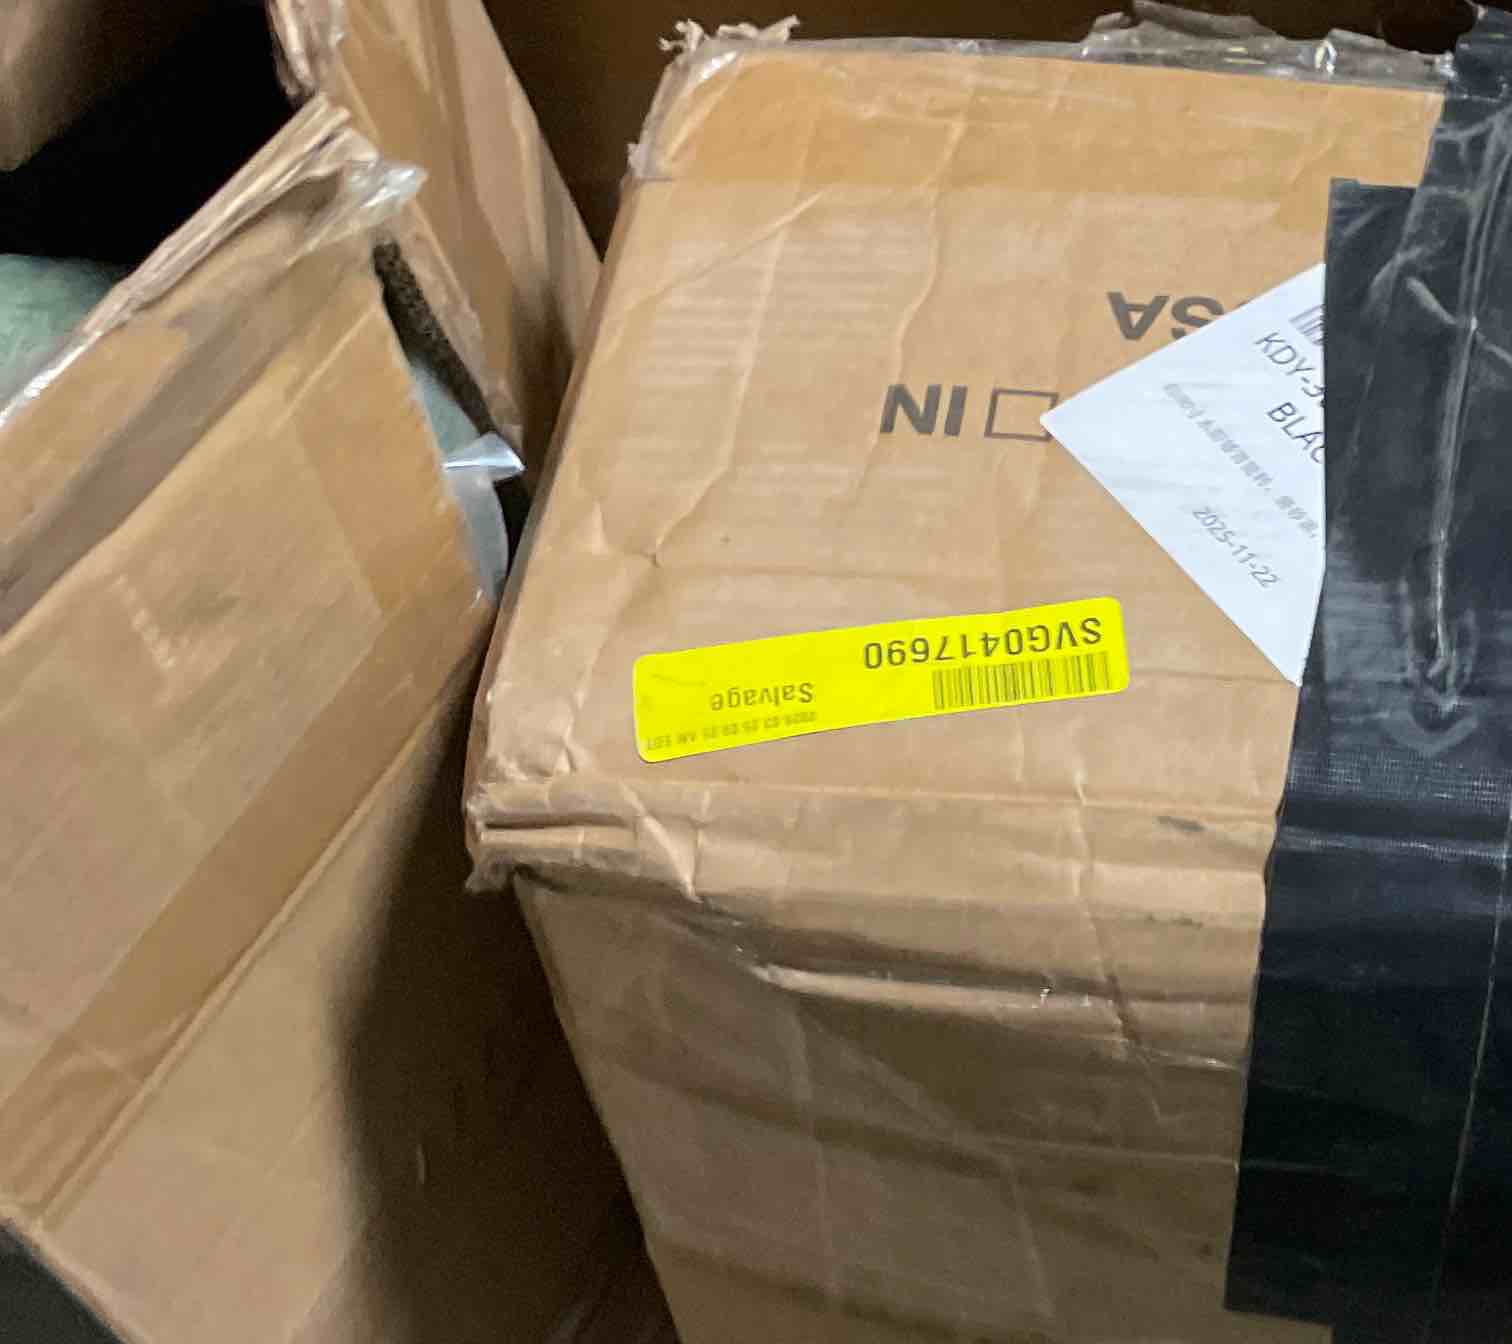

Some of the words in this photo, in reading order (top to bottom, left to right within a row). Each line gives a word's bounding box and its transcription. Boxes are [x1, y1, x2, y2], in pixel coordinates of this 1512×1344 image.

[879, 383, 969, 437] IN
[863, 617, 1103, 670] SVG0417690
[710, 680, 816, 712] Salvage
